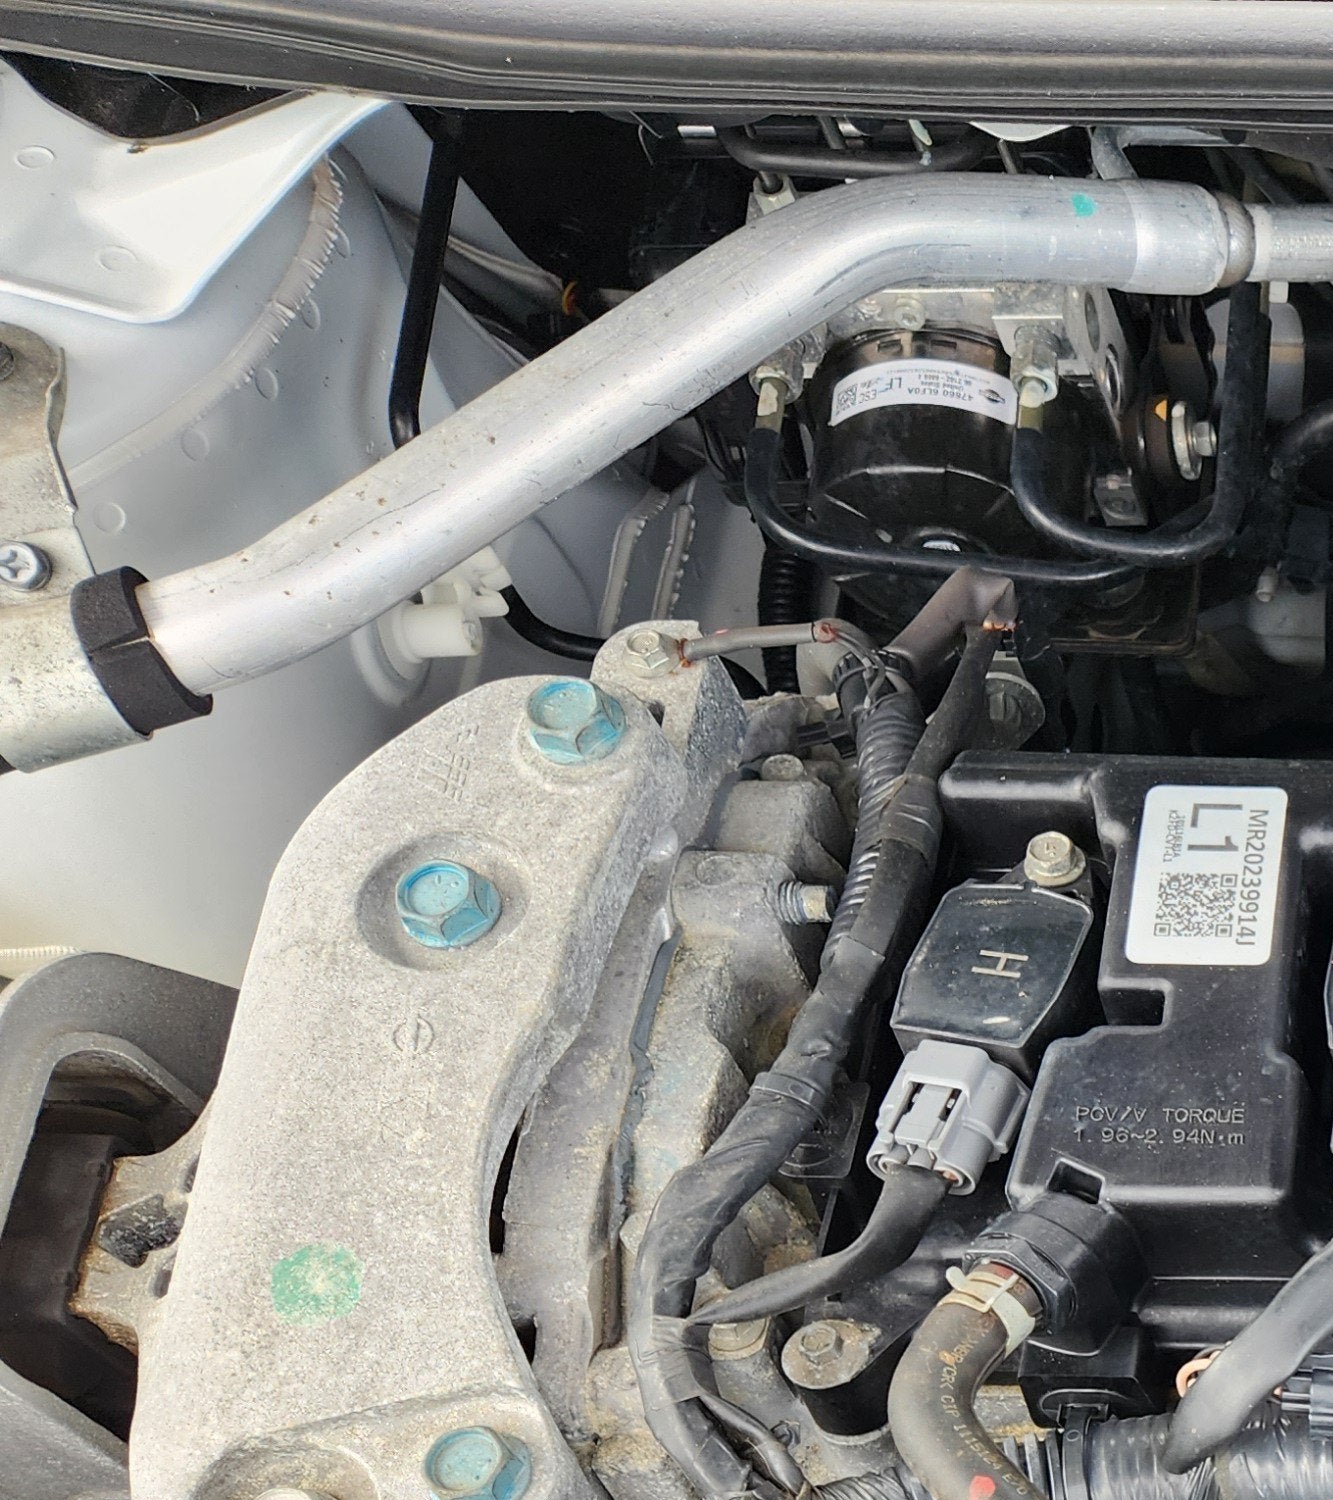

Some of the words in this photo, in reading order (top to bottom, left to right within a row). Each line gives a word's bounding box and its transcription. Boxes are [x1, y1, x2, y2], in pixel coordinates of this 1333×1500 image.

[1187, 803, 1243, 852] L1
[1235, 809, 1269, 946] MR20239914J
[1162, 1106, 1246, 1125] TORQUE
